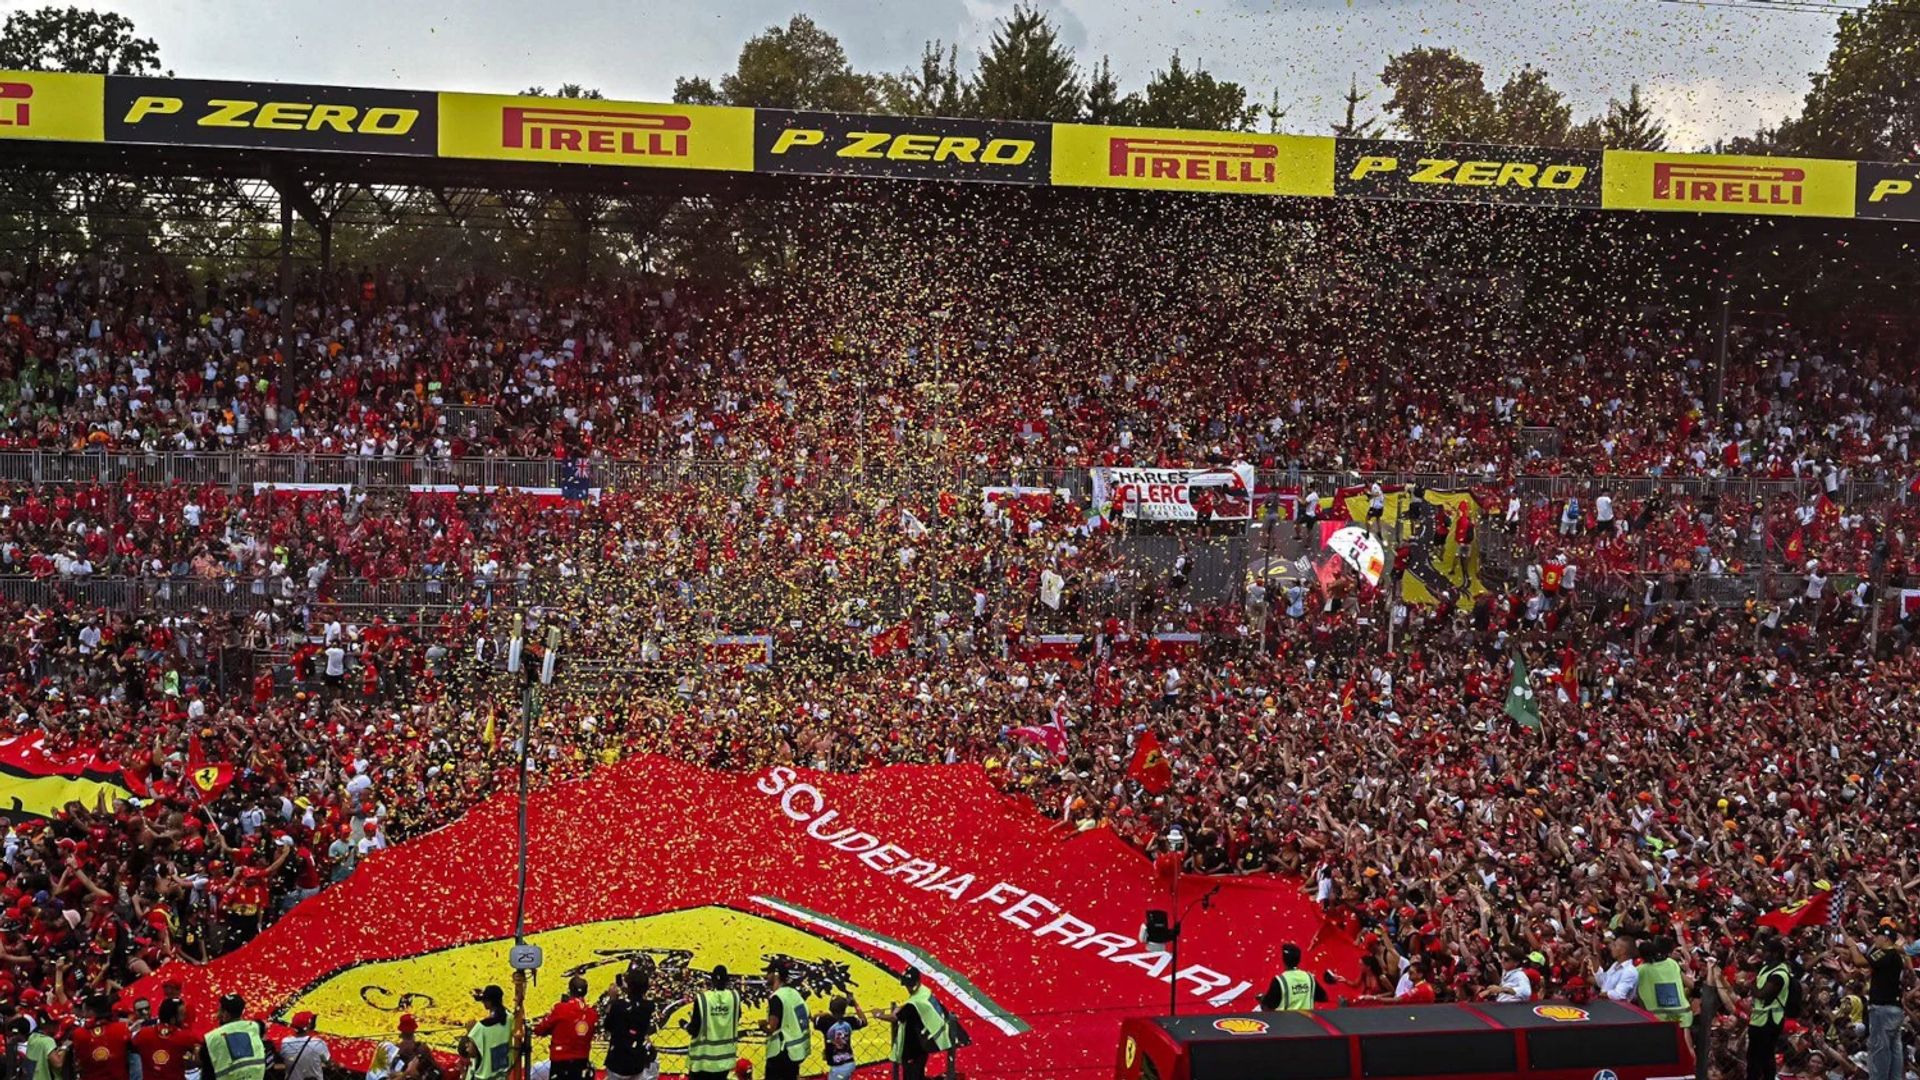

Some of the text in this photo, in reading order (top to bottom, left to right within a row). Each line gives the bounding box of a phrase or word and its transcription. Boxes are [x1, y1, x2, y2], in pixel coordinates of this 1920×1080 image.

[124, 96, 419, 135] P ZERO
[502, 106, 691, 157] PIRELLI
[769, 129, 1036, 166] P ZERO
[1110, 137, 1278, 182] PIRELLI
[1349, 155, 1588, 191] P ZERO
[1653, 162, 1806, 205] PIRELLI
[1868, 179, 1914, 203] P
[756, 765, 1254, 1007] SCUDERIA FERRARI
[518, 952, 536, 964] 25
